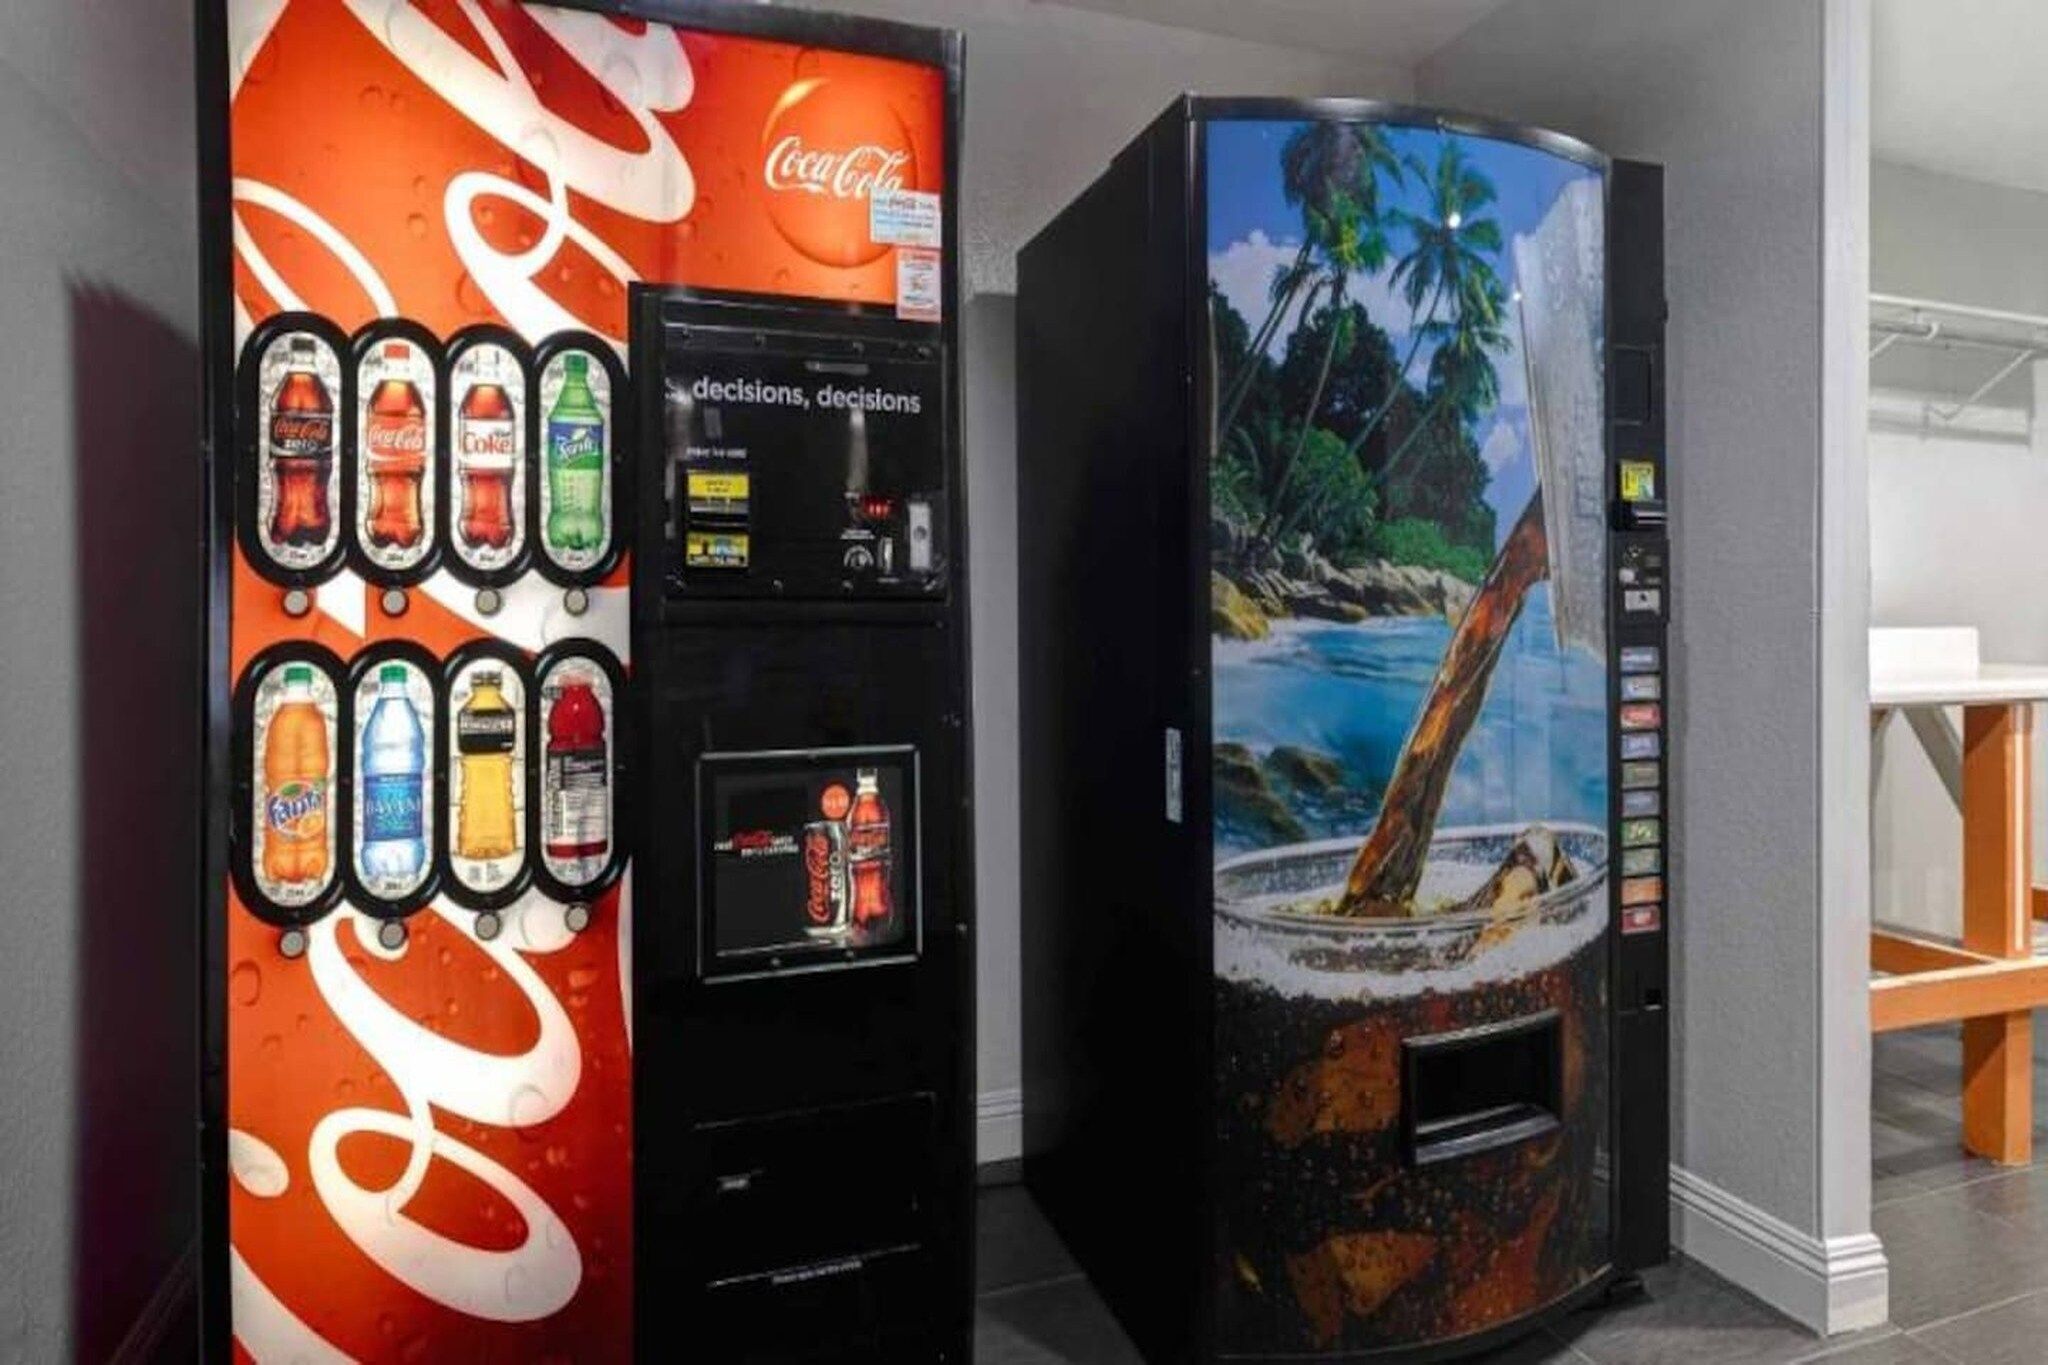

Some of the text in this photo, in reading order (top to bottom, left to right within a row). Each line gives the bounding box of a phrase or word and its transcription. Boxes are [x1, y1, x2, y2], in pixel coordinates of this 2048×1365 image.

[692, 376, 921, 414] decisions, decisions
[463, 431, 512, 454] Coke
